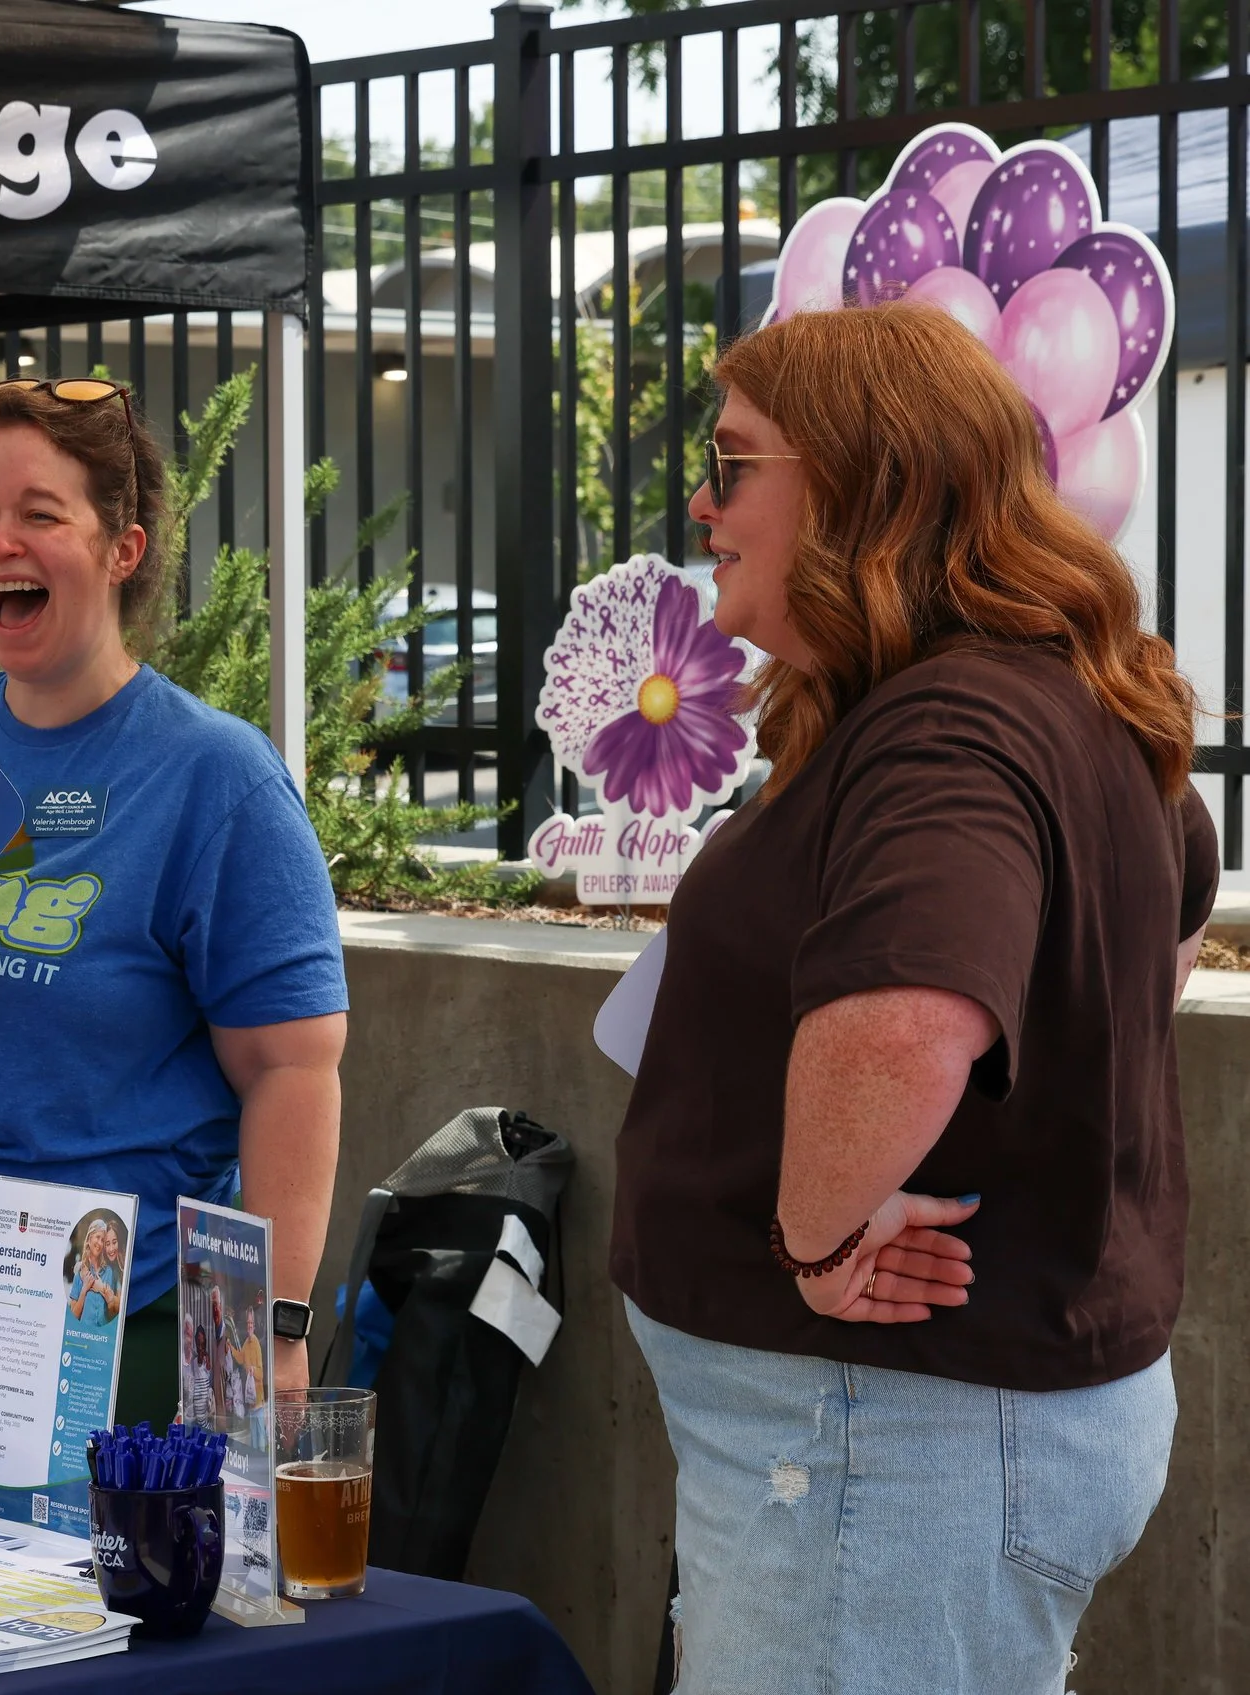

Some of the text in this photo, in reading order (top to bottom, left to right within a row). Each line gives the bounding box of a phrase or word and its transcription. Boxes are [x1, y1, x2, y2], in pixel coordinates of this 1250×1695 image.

[43, 791, 91, 804] ACCA
[57, 818, 95, 826] Kimbrough
[617, 820, 690, 867] Hope
[584, 874, 639, 893] EPILEPSY
[33, 962, 60, 985] IT
[187, 1227, 258, 1264] Volunteer with ACCA
[15, 1285, 53, 1299] Conversation
[66, 1330, 81, 1338] EVENT
[1, 1620, 75, 1639] HOPE
